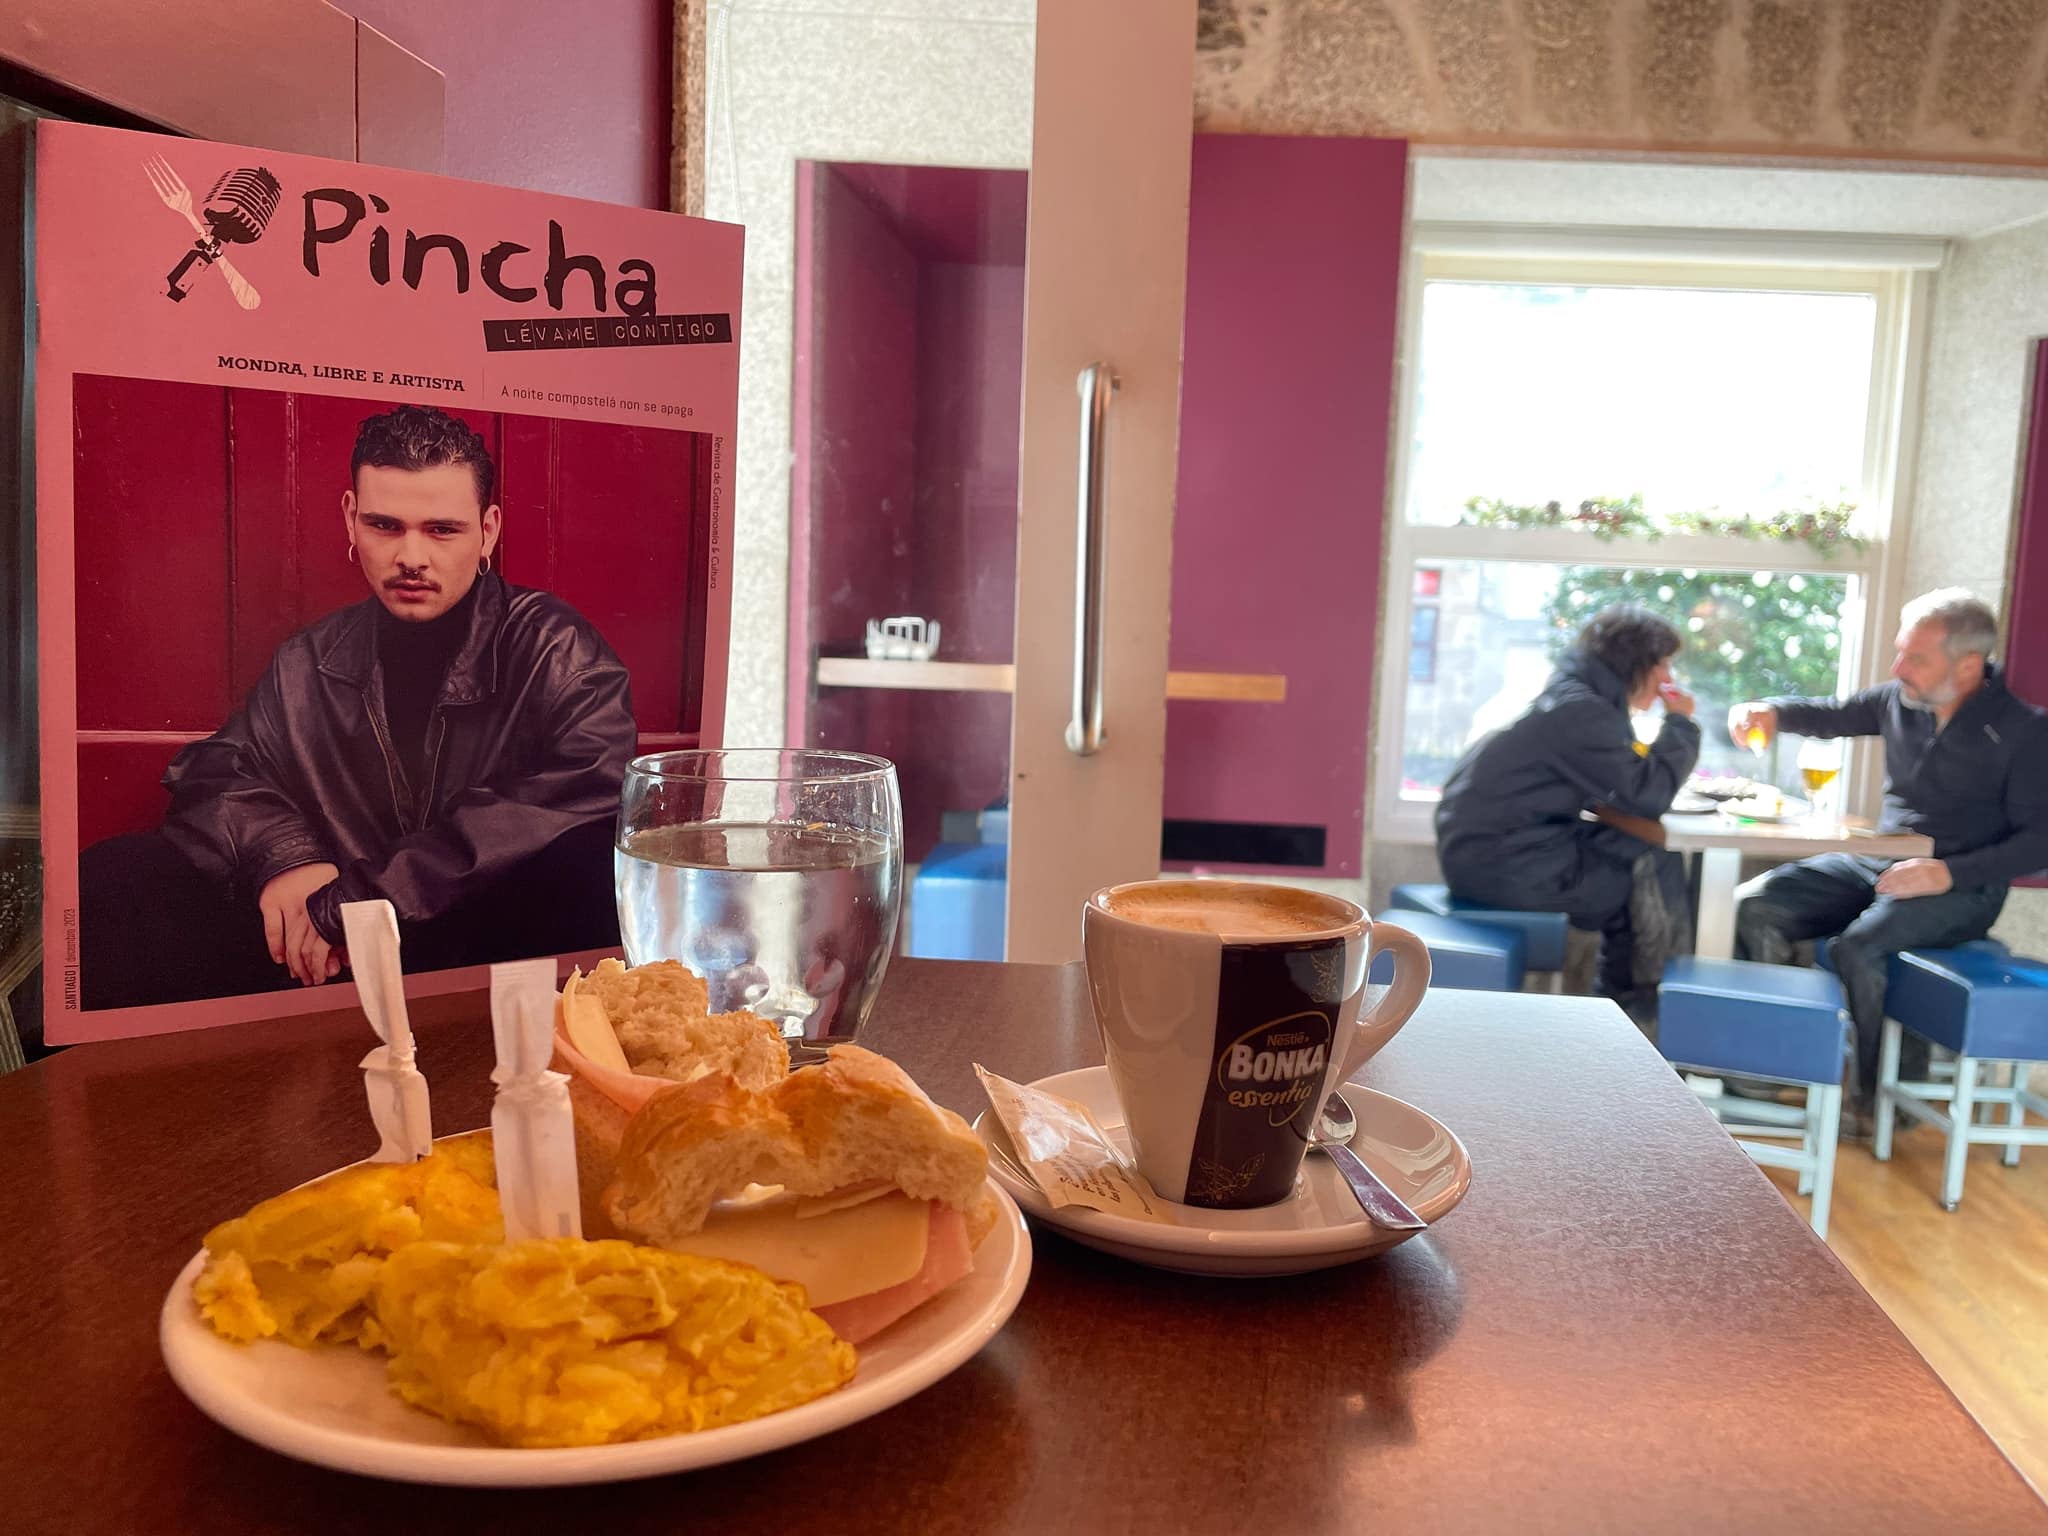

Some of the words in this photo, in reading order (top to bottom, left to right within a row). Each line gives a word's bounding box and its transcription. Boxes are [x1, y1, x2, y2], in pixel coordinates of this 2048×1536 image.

[303, 187, 657, 317] Pincha
[504, 322, 596, 343] LÉVAME
[615, 322, 716, 339] CONTIGO
[217, 355, 307, 378] MONDRA,
[313, 365, 367, 382] LIBRE
[373, 371, 384, 383] E
[389, 373, 465, 391] ARTISTA
[501, 385, 509, 397] A
[513, 387, 544, 401] noite
[548, 391, 616, 408] compostelá
[620, 400, 640, 411] non
[644, 402, 657, 412] se
[661, 404, 694, 418] apaga
[713, 437, 723, 470] Revista
[713, 472, 722, 486] de
[710, 556, 720, 590] Cultura
[64, 908, 76, 927] 2023
[64, 970, 77, 1011] SANTIAGO
[1228, 1043, 1326, 1082] BONKA
